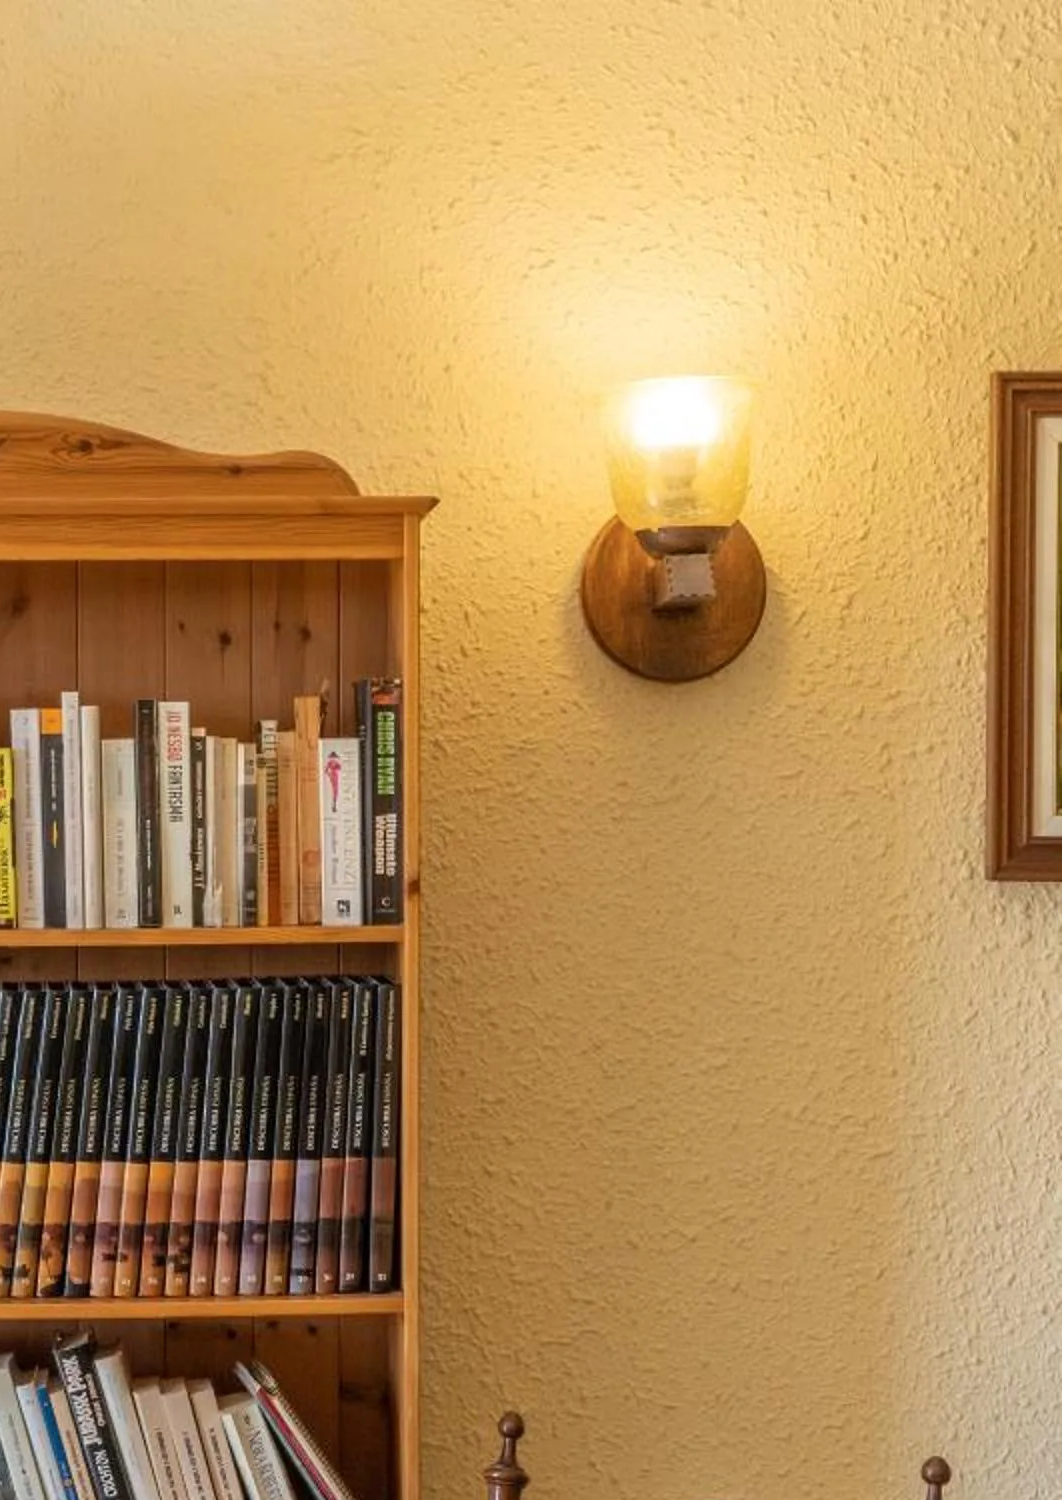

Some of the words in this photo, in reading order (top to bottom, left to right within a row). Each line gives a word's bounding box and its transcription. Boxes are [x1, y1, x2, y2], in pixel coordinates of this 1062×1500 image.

[167, 710, 183, 723] JO
[376, 711, 395, 755] CHRIS
[167, 765, 183, 823] FANTASMA
[376, 757, 395, 795] RYAN
[374, 814, 386, 876] Weapon
[385, 813, 398, 877] Ultimate
[61, 1355, 85, 1393] PARK
[73, 1391, 102, 1446] JURASSIC
[93, 1448, 117, 1498] CRICHTON
